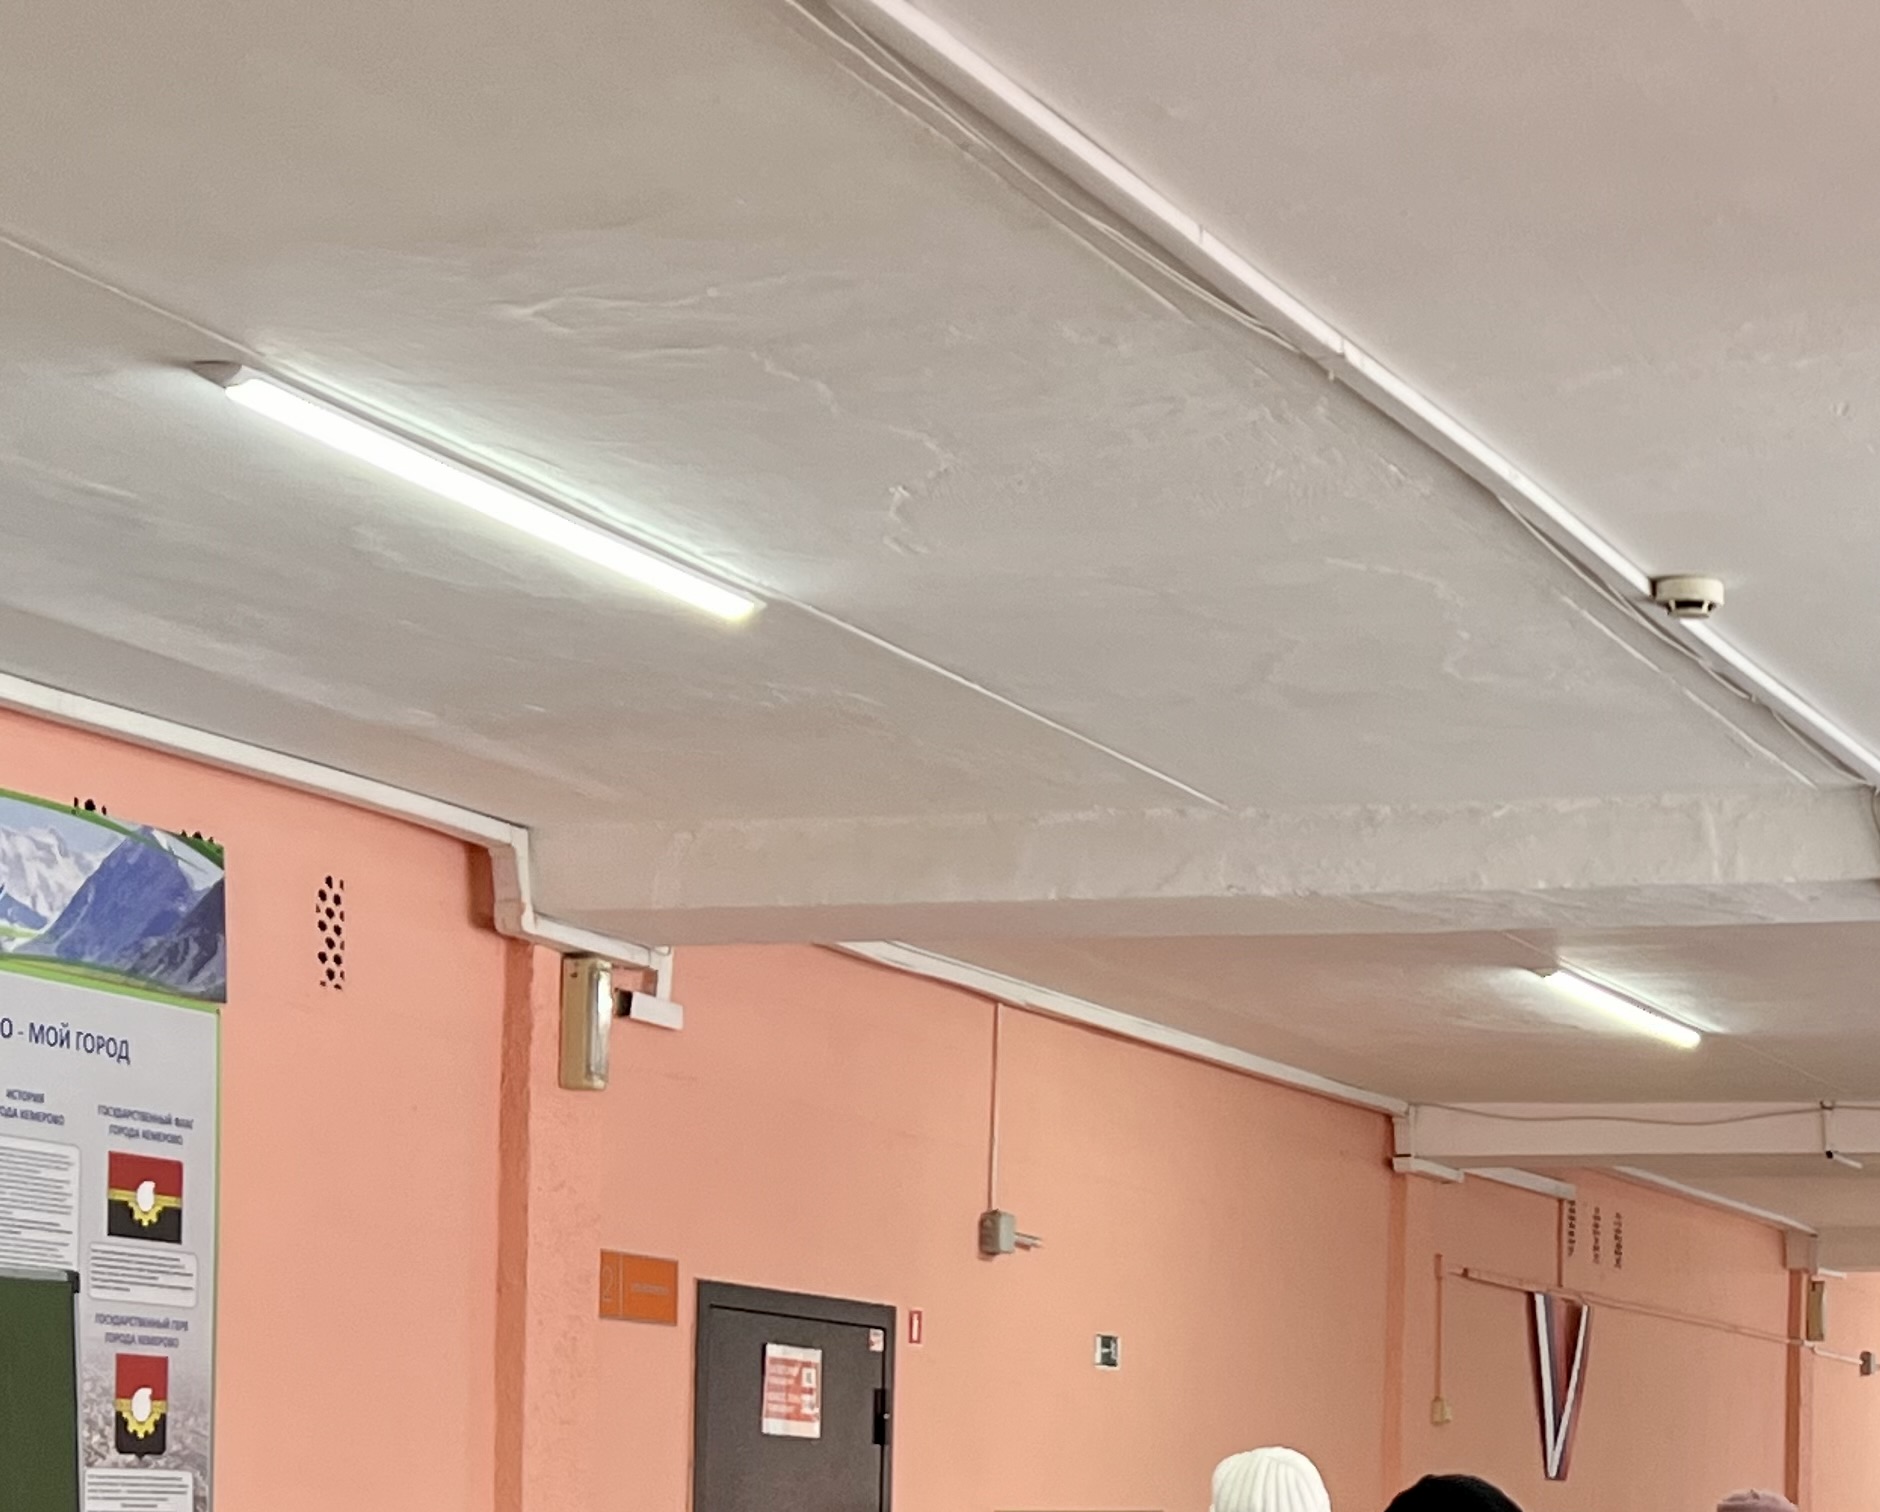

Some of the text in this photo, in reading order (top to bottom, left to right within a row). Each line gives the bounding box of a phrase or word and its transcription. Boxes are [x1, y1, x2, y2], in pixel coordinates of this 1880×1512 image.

[0, 1017, 13, 1038] О
[28, 1021, 70, 1050] МОЙ
[75, 1031, 131, 1066] ГОРОД
